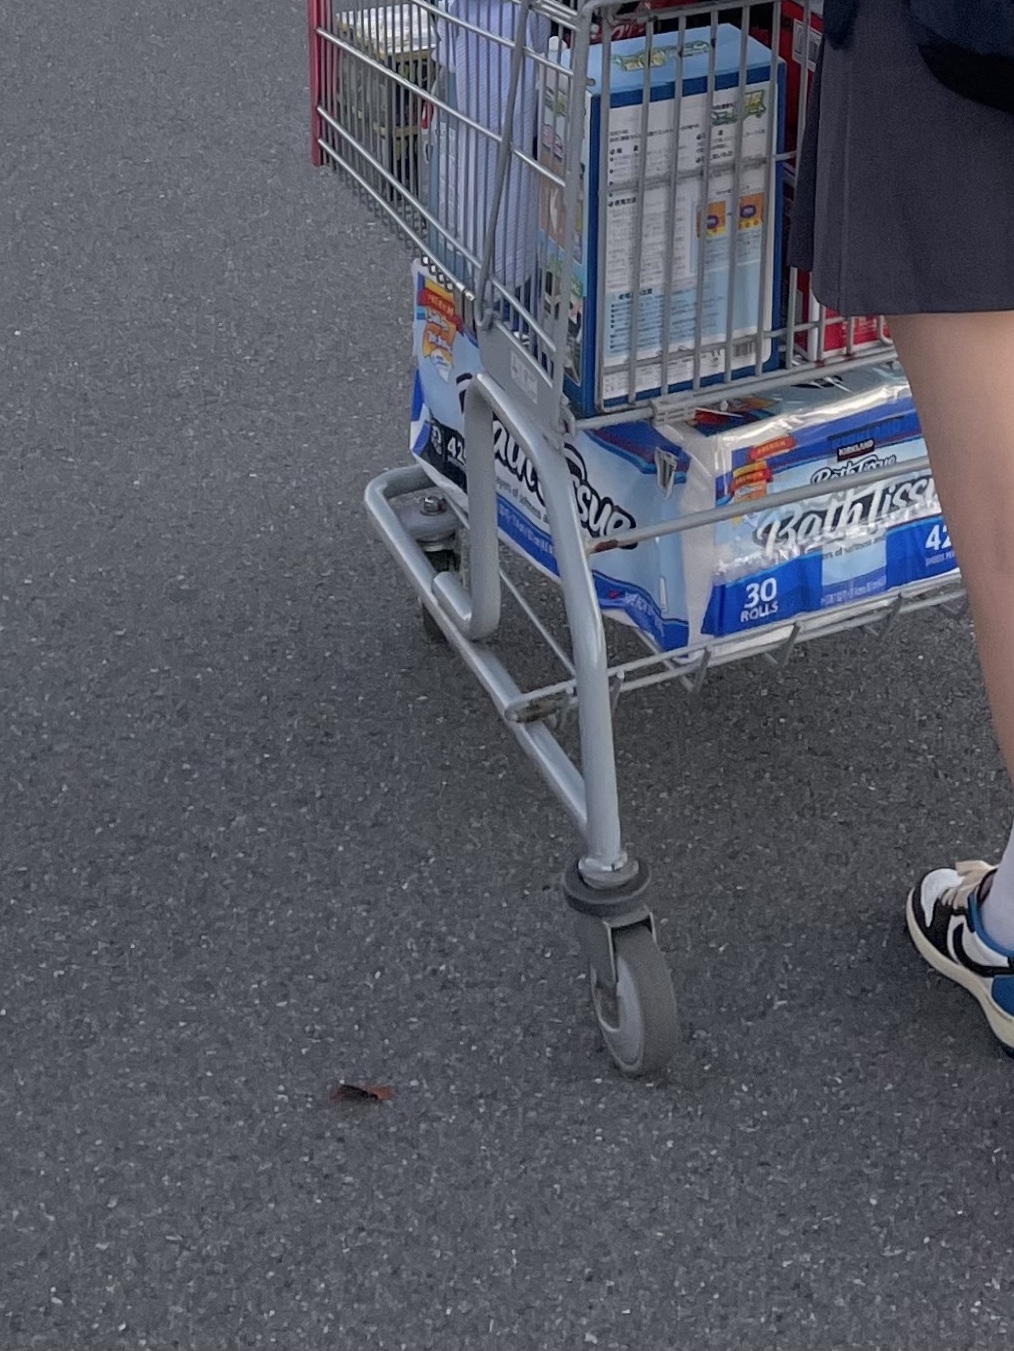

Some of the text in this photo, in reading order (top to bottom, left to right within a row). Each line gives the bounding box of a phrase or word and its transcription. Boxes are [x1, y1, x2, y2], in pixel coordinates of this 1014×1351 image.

[756, 486, 864, 557] Bath
[745, 577, 777, 609] 30
[740, 600, 779, 623] ROLLS
